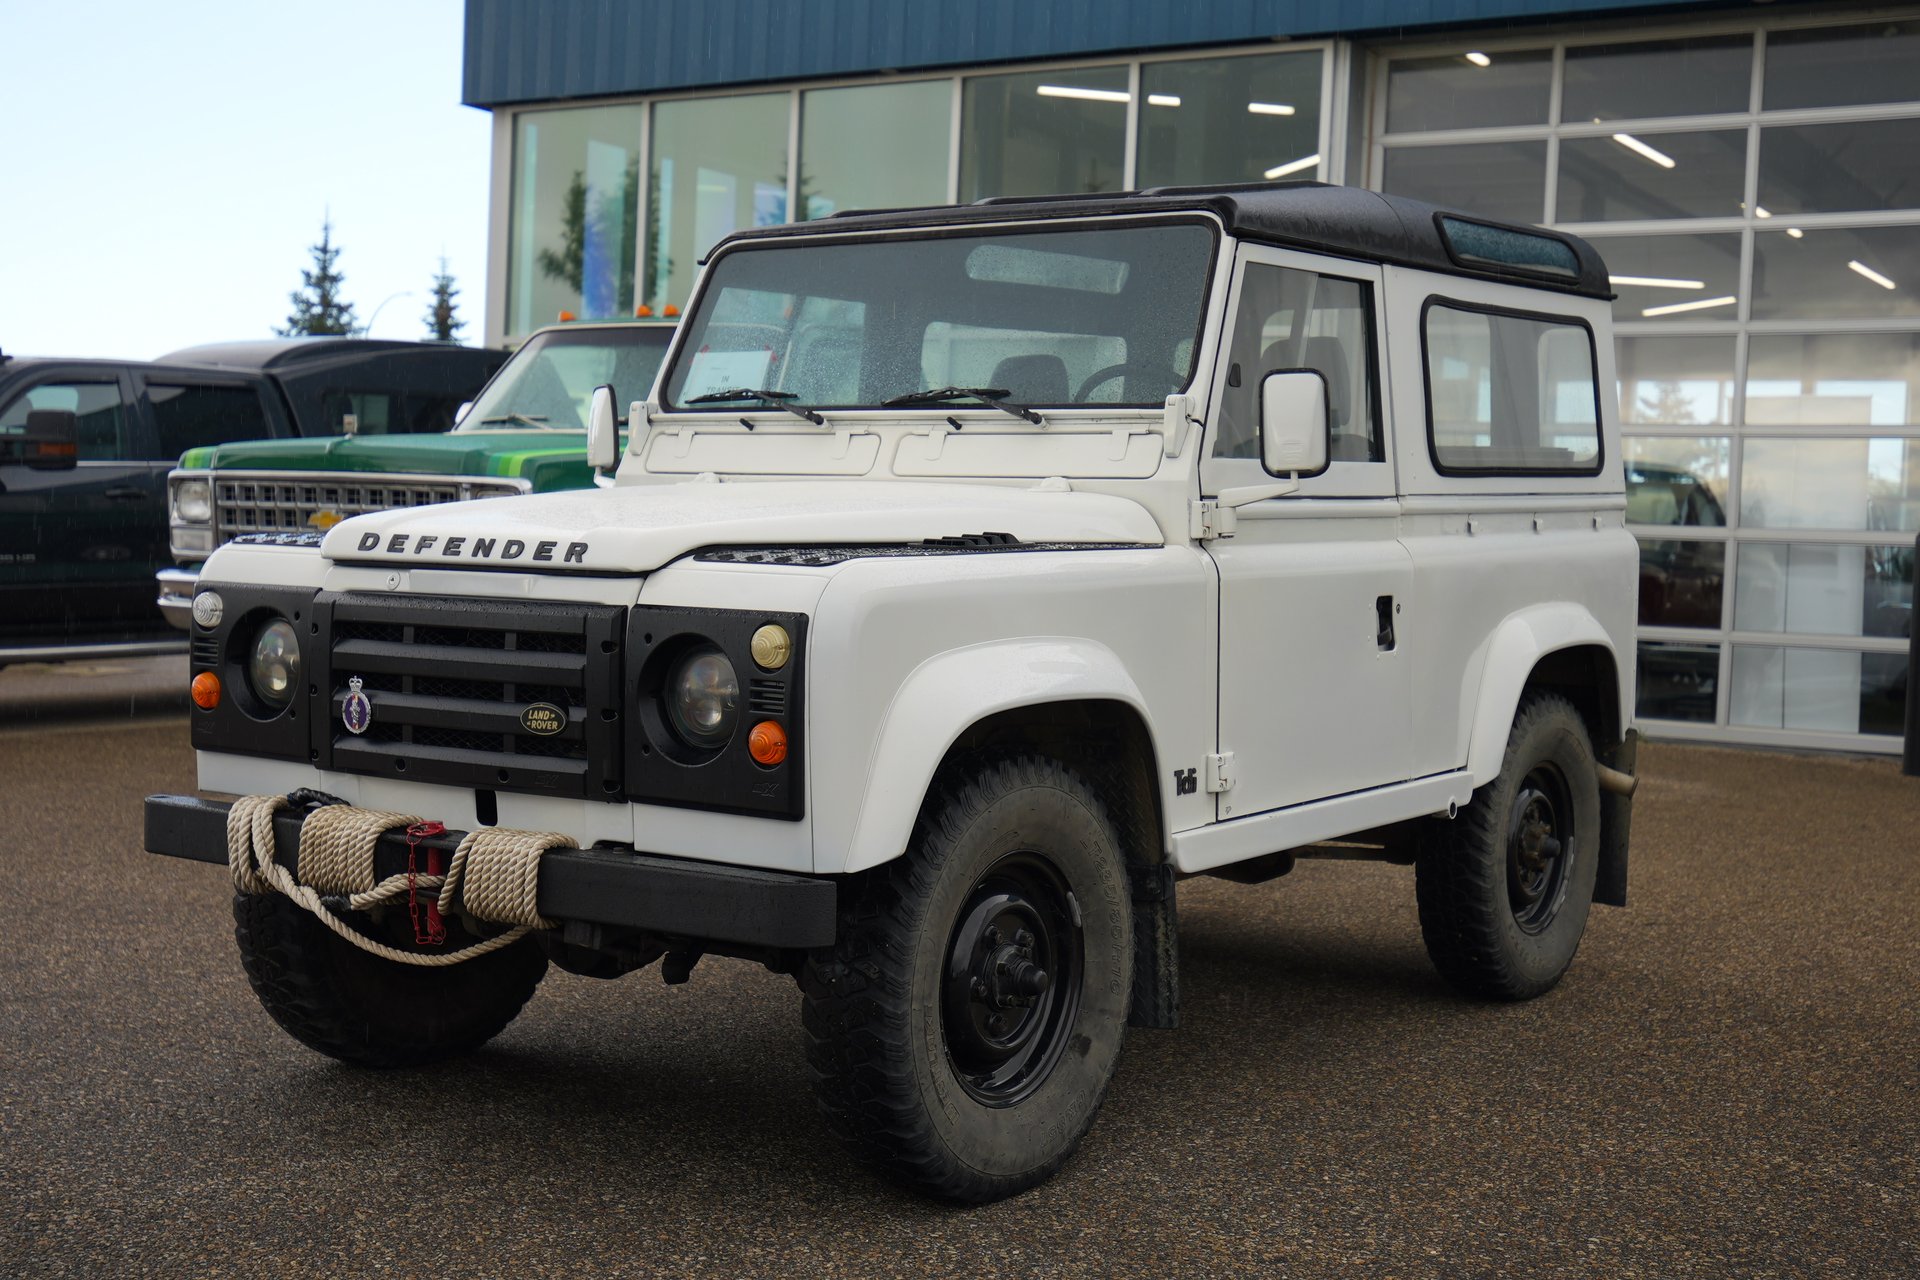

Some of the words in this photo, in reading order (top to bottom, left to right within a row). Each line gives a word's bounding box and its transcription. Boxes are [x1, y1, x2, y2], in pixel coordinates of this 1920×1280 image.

[357, 532, 589, 563] DEFENDER
[528, 709, 550, 720] LAND
[531, 720, 558, 730] ROVER
